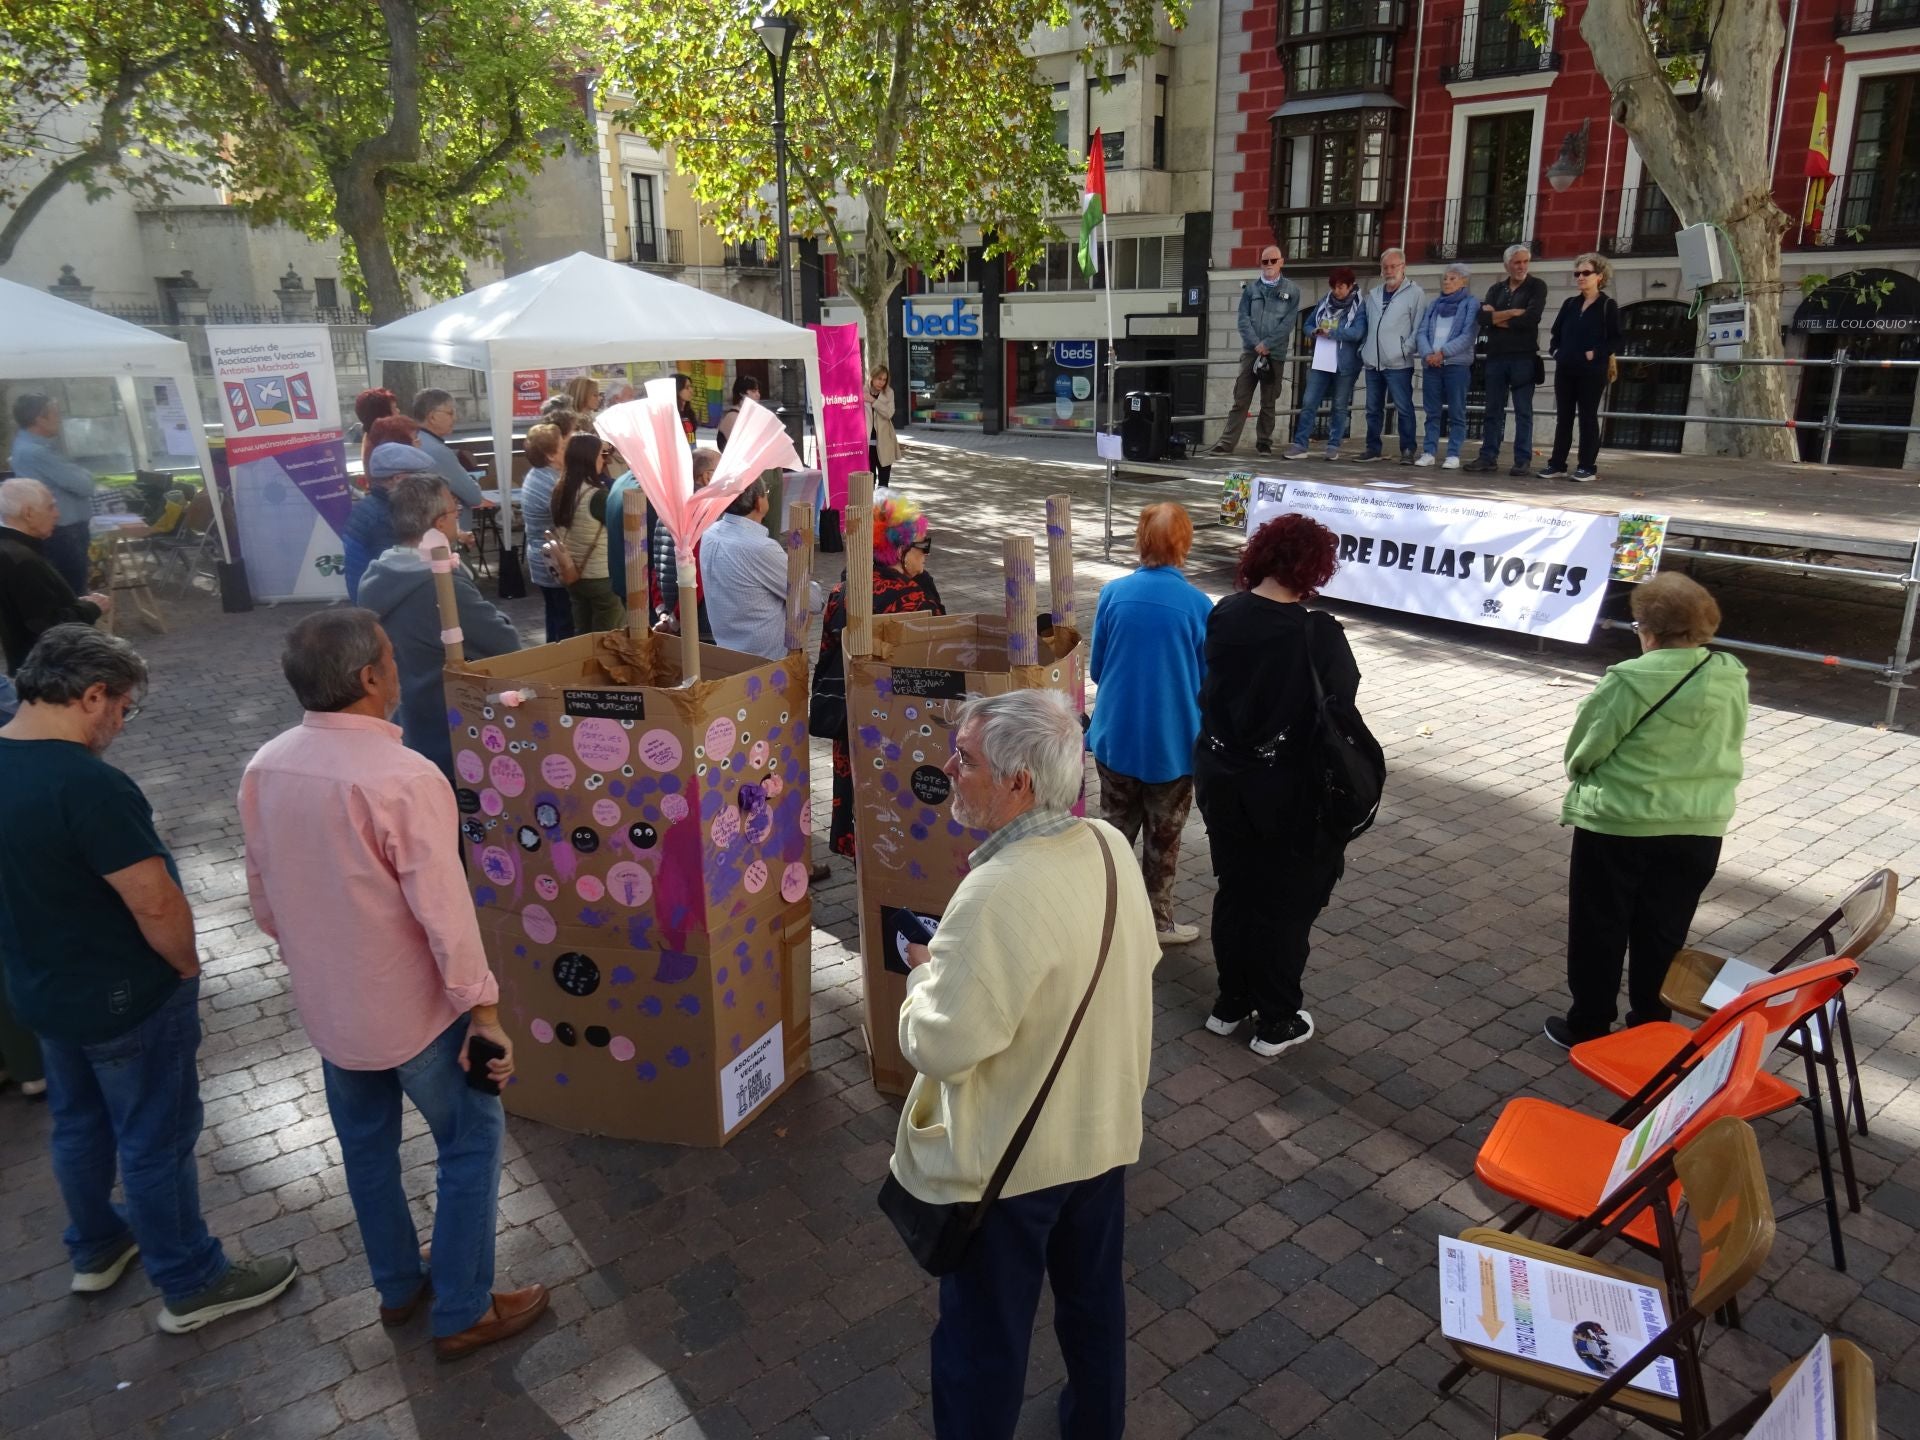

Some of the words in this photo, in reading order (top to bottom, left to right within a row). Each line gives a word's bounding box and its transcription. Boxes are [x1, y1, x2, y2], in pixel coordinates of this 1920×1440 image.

[905, 297, 979, 337] bed's
[1797, 319, 1823, 329] HOTEL
[1826, 319, 1839, 329] EL
[1841, 319, 1907, 330] COLOQUIO
[214, 344, 265, 357] Federación
[267, 344, 279, 352] de
[217, 355, 273, 367] Asociaciones
[274, 350, 316, 361] Vecinales
[1060, 343, 1093, 360] bed's
[219, 367, 256, 377] Antonio
[257, 361, 300, 373] Machado
[825, 394, 859, 405] triángulo
[1292, 488, 1327, 500] Federación
[1328, 491, 1360, 504] Provincial
[1360, 496, 1369, 504] de
[1370, 498, 1415, 510] Asociaciones
[1415, 503, 1449, 514] Vecinales
[1451, 507, 1460, 515] de
[1461, 507, 1497, 519] Valladoli
[1332, 533, 1375, 564] RE
[1378, 539, 1418, 571] DE
[1421, 545, 1476, 580] LAS
[1483, 553, 1588, 597] VOCES
[924, 670, 951, 678] CERCA
[914, 679, 945, 688] ZONAS
[566, 692, 599, 700] CENTRO
[920, 791, 933, 799] TO
[740, 1054, 767, 1079] VECINAL
[1654, 1364, 1676, 1394] Vecinal
